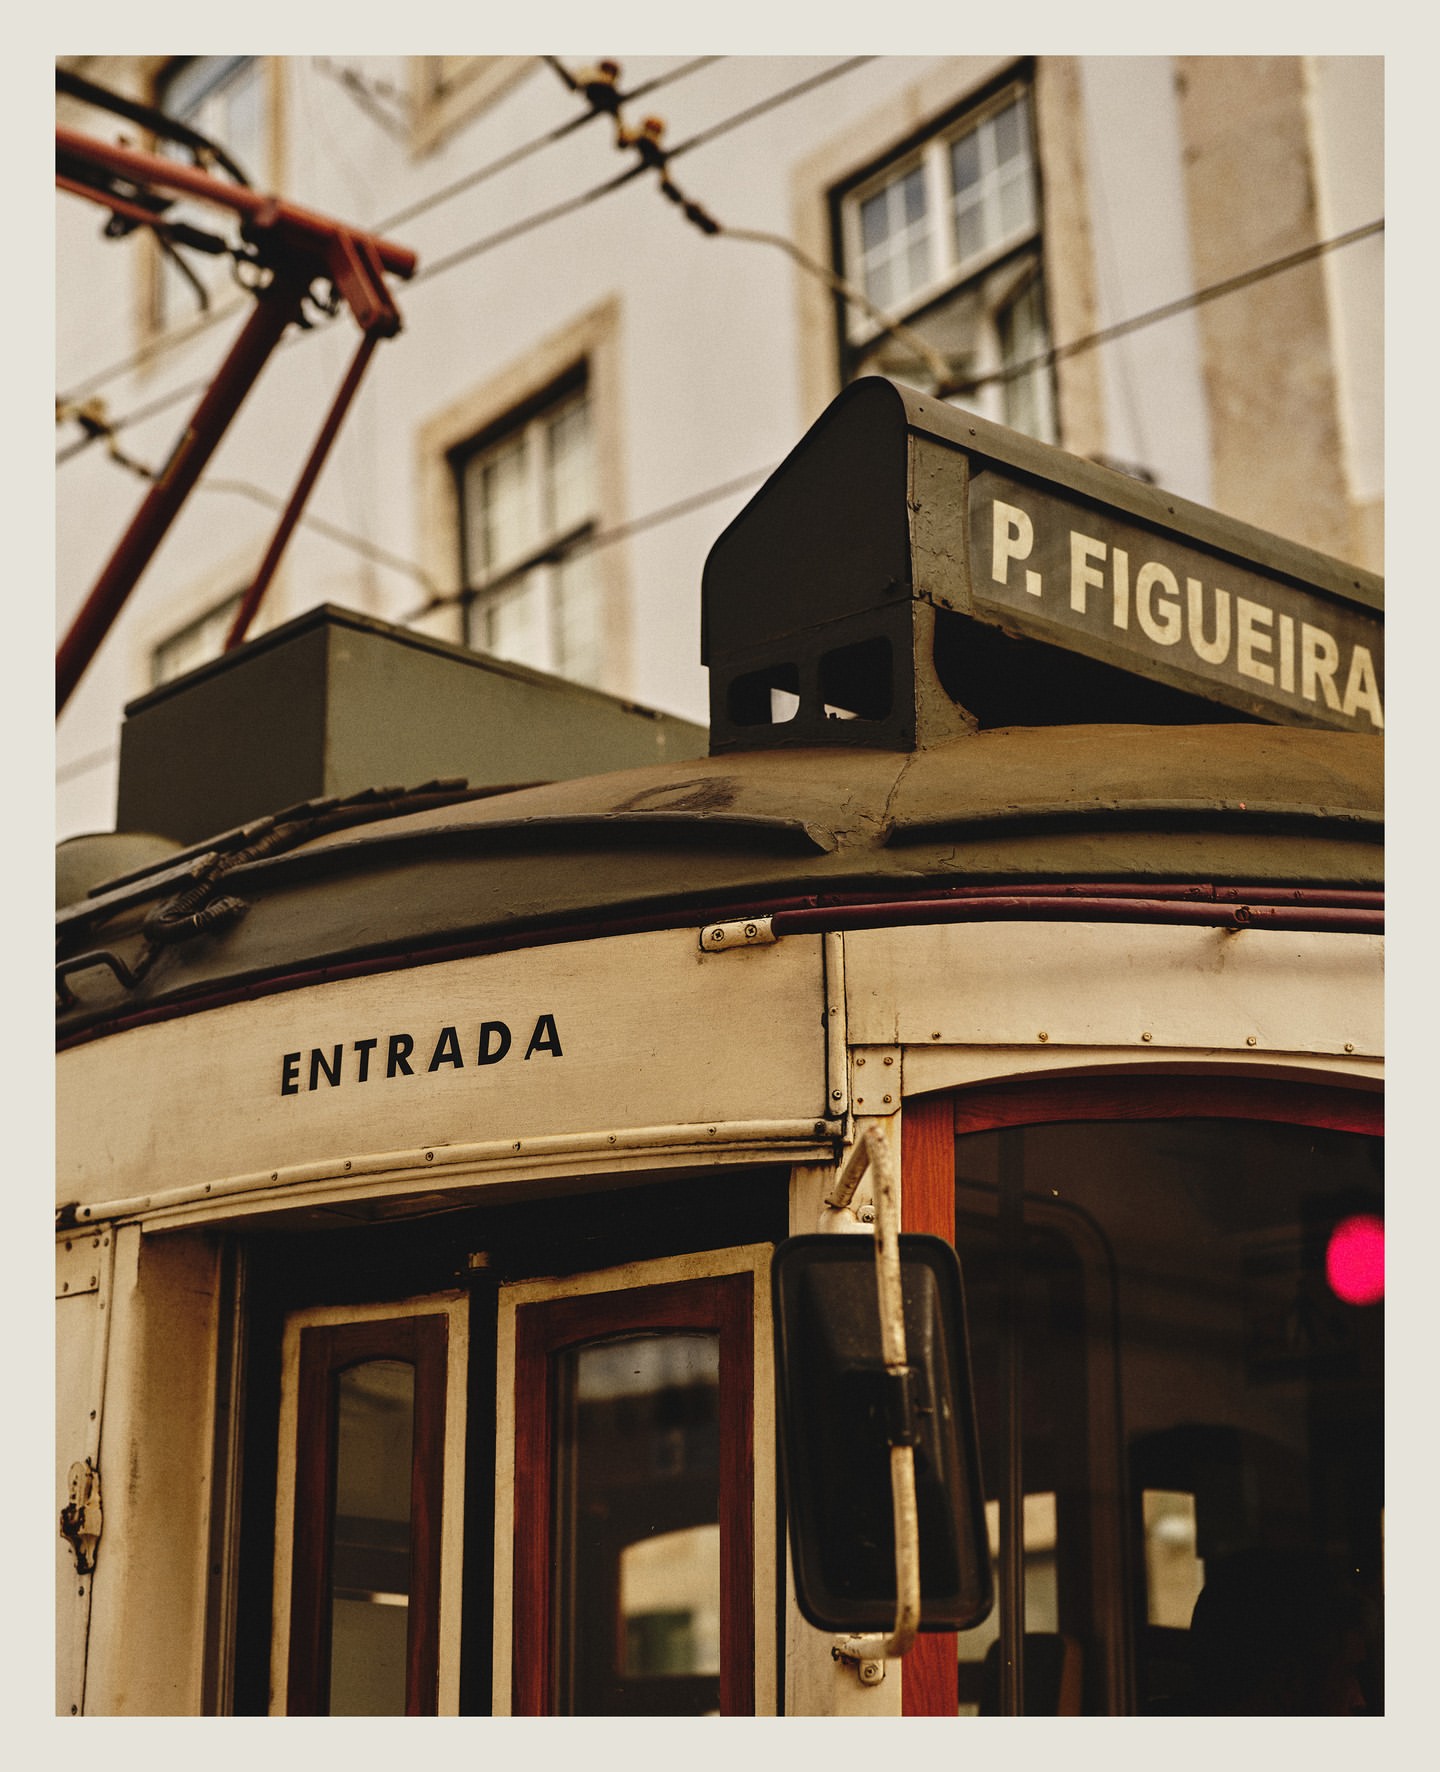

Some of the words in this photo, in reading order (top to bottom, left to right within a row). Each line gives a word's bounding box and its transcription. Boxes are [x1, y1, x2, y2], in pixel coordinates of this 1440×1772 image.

[991, 499, 1042, 597] P.
[1070, 530, 1384, 729] FIGUEIRA
[281, 1013, 563, 1096] ENTRADA
